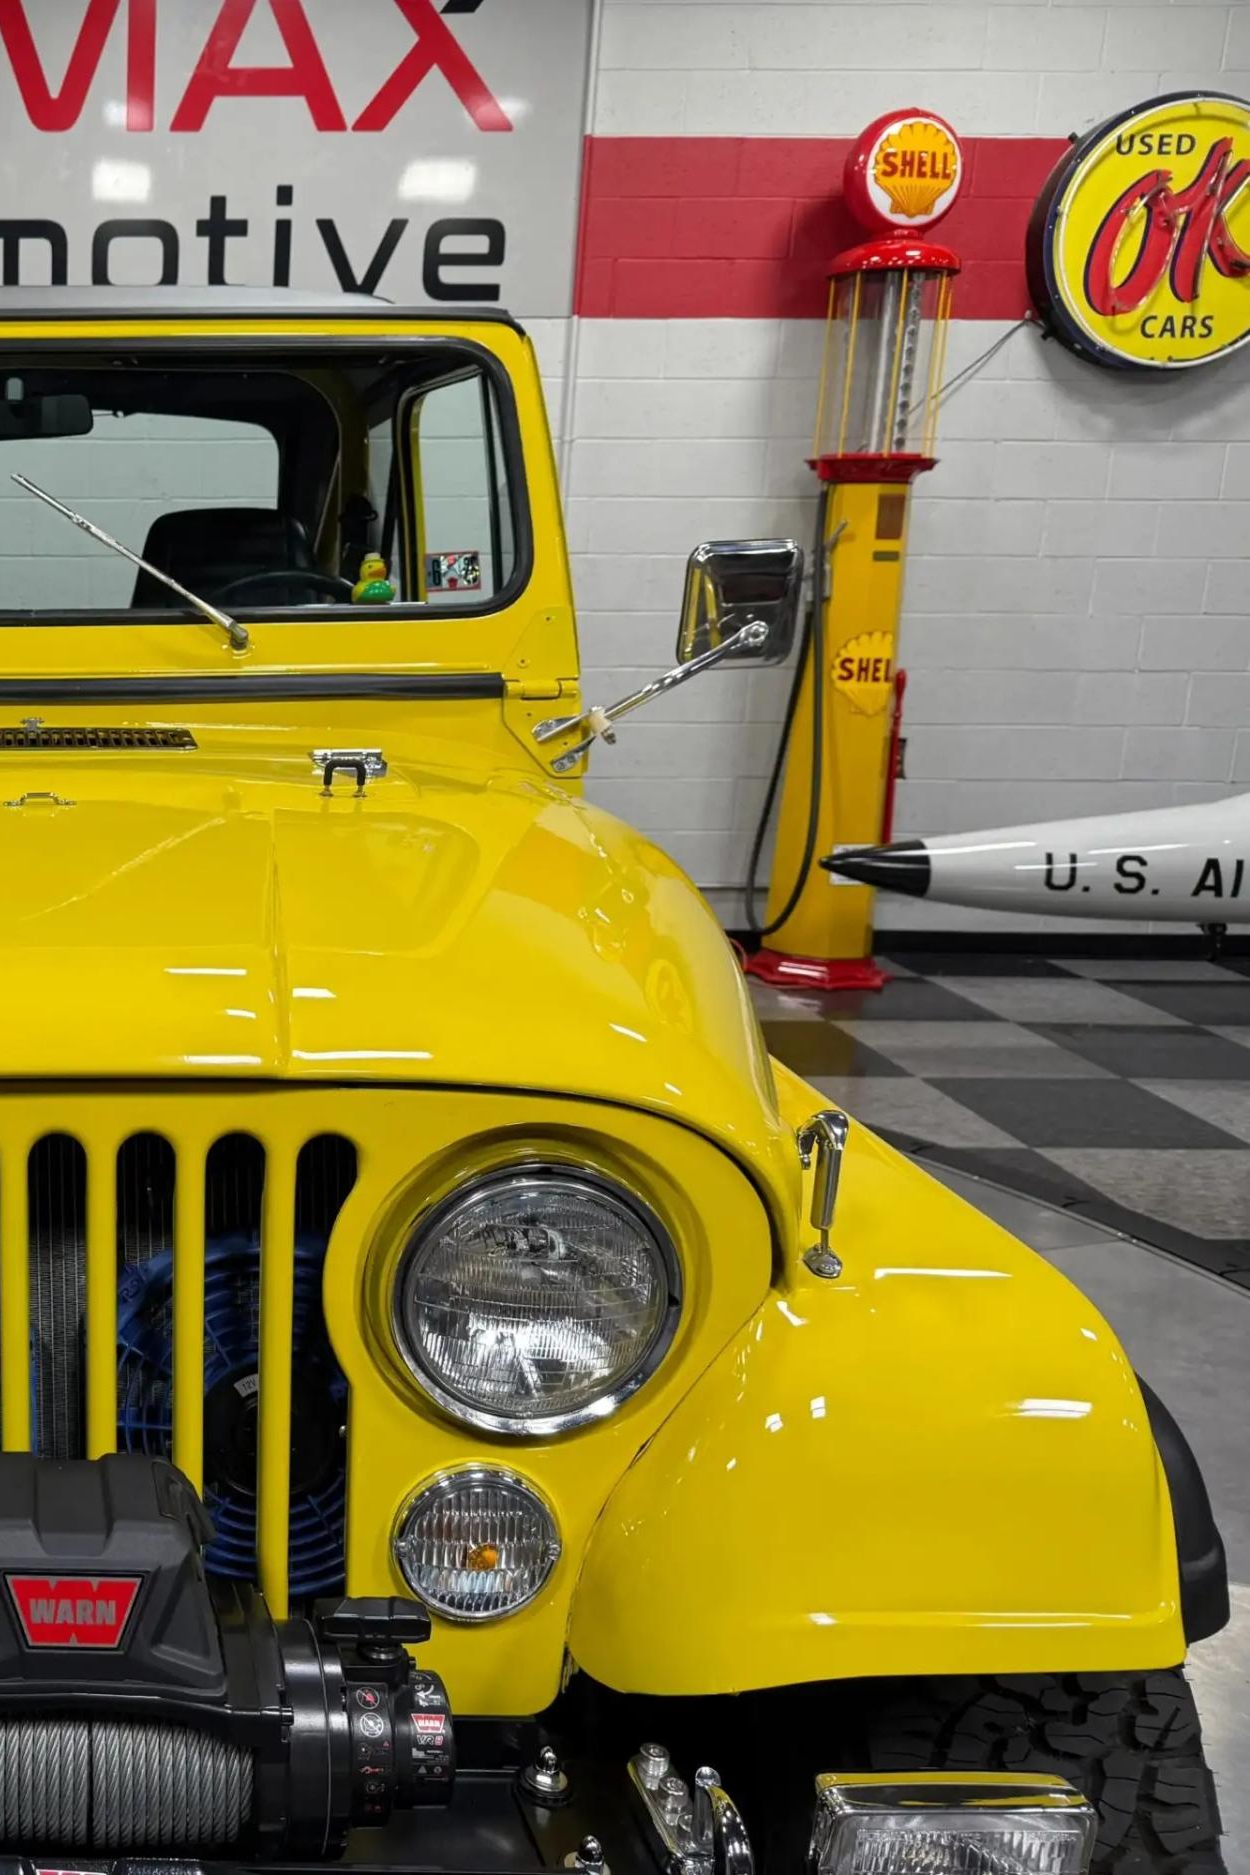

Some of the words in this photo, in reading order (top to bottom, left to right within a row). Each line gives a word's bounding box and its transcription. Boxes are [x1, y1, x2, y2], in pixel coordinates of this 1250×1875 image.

[1116, 133, 1196, 156] USED
[880, 150, 951, 180] SHELL
[1084, 137, 1250, 316] OK
[1140, 316, 1214, 339] CARS
[29, 1598, 117, 1625] WARN
